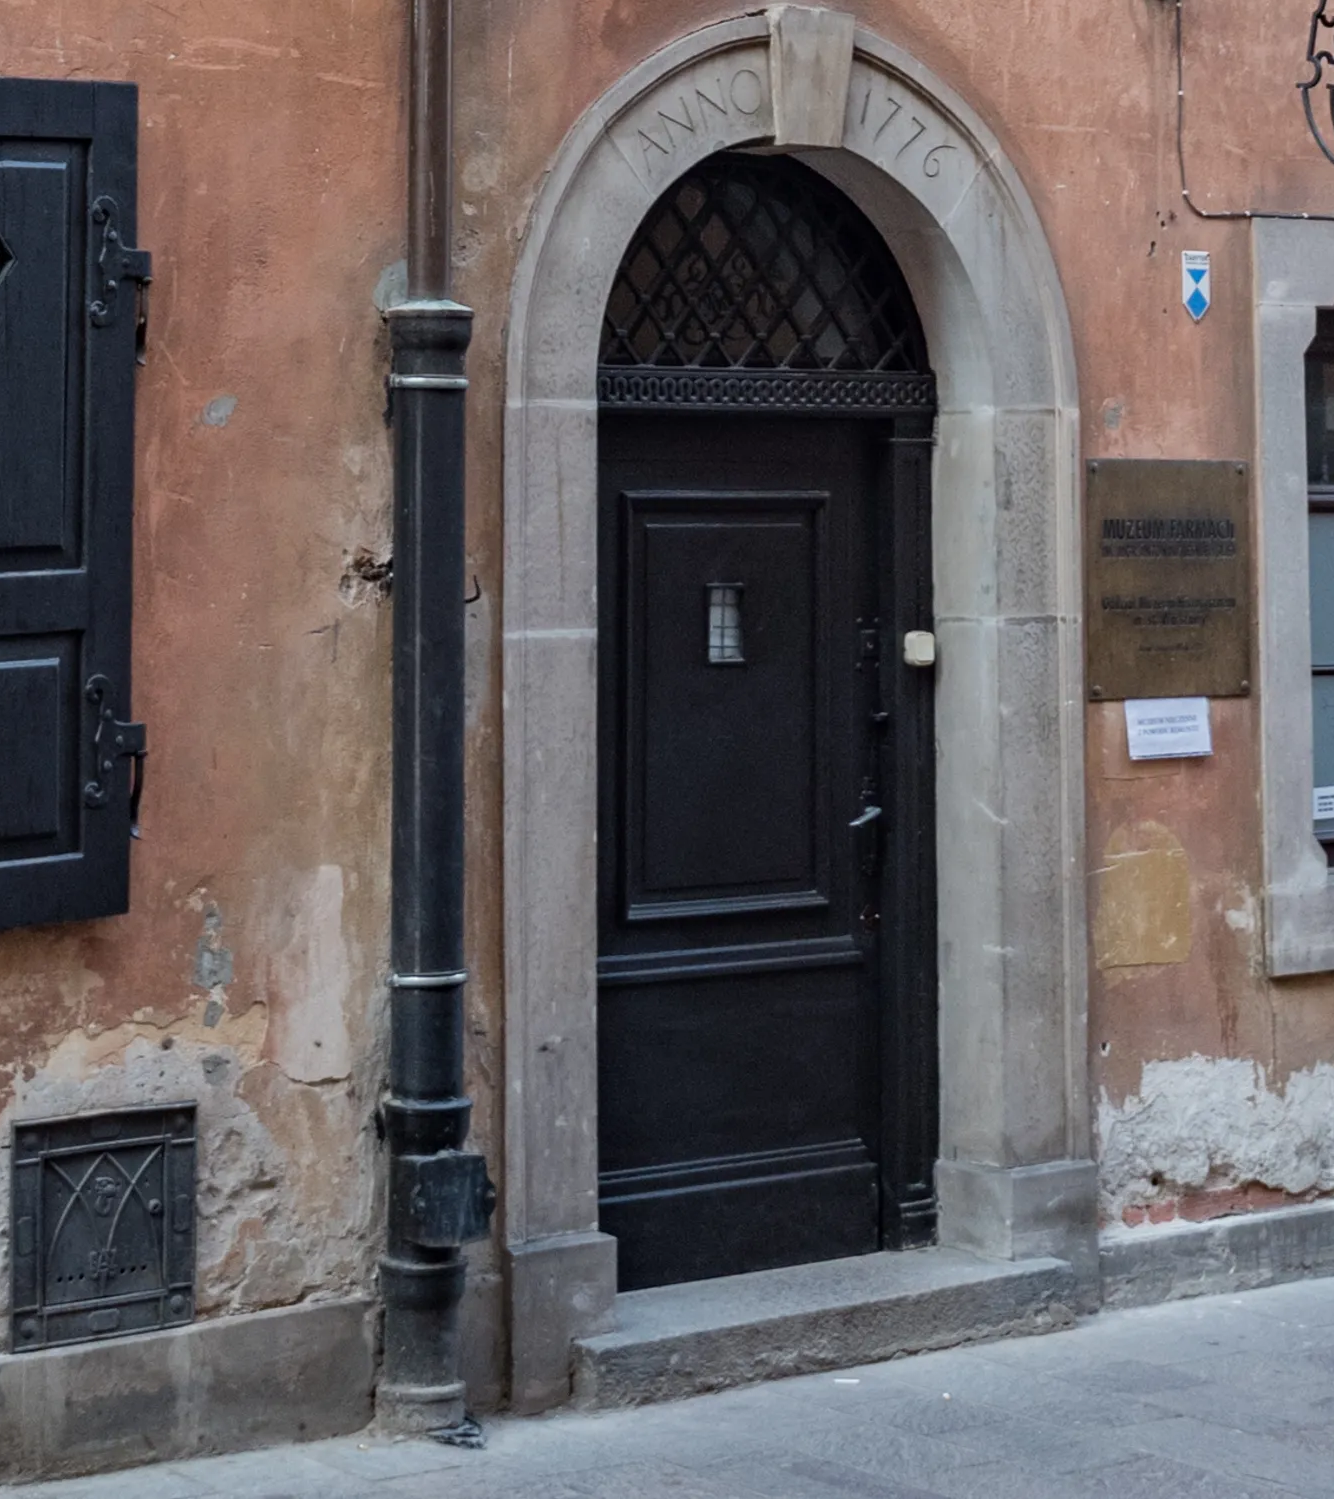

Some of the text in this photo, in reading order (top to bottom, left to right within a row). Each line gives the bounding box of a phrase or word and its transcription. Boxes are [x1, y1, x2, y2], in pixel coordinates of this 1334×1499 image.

[637, 69, 957, 178] ANNO 1776
[1102, 518, 1165, 540] MUZEUM
